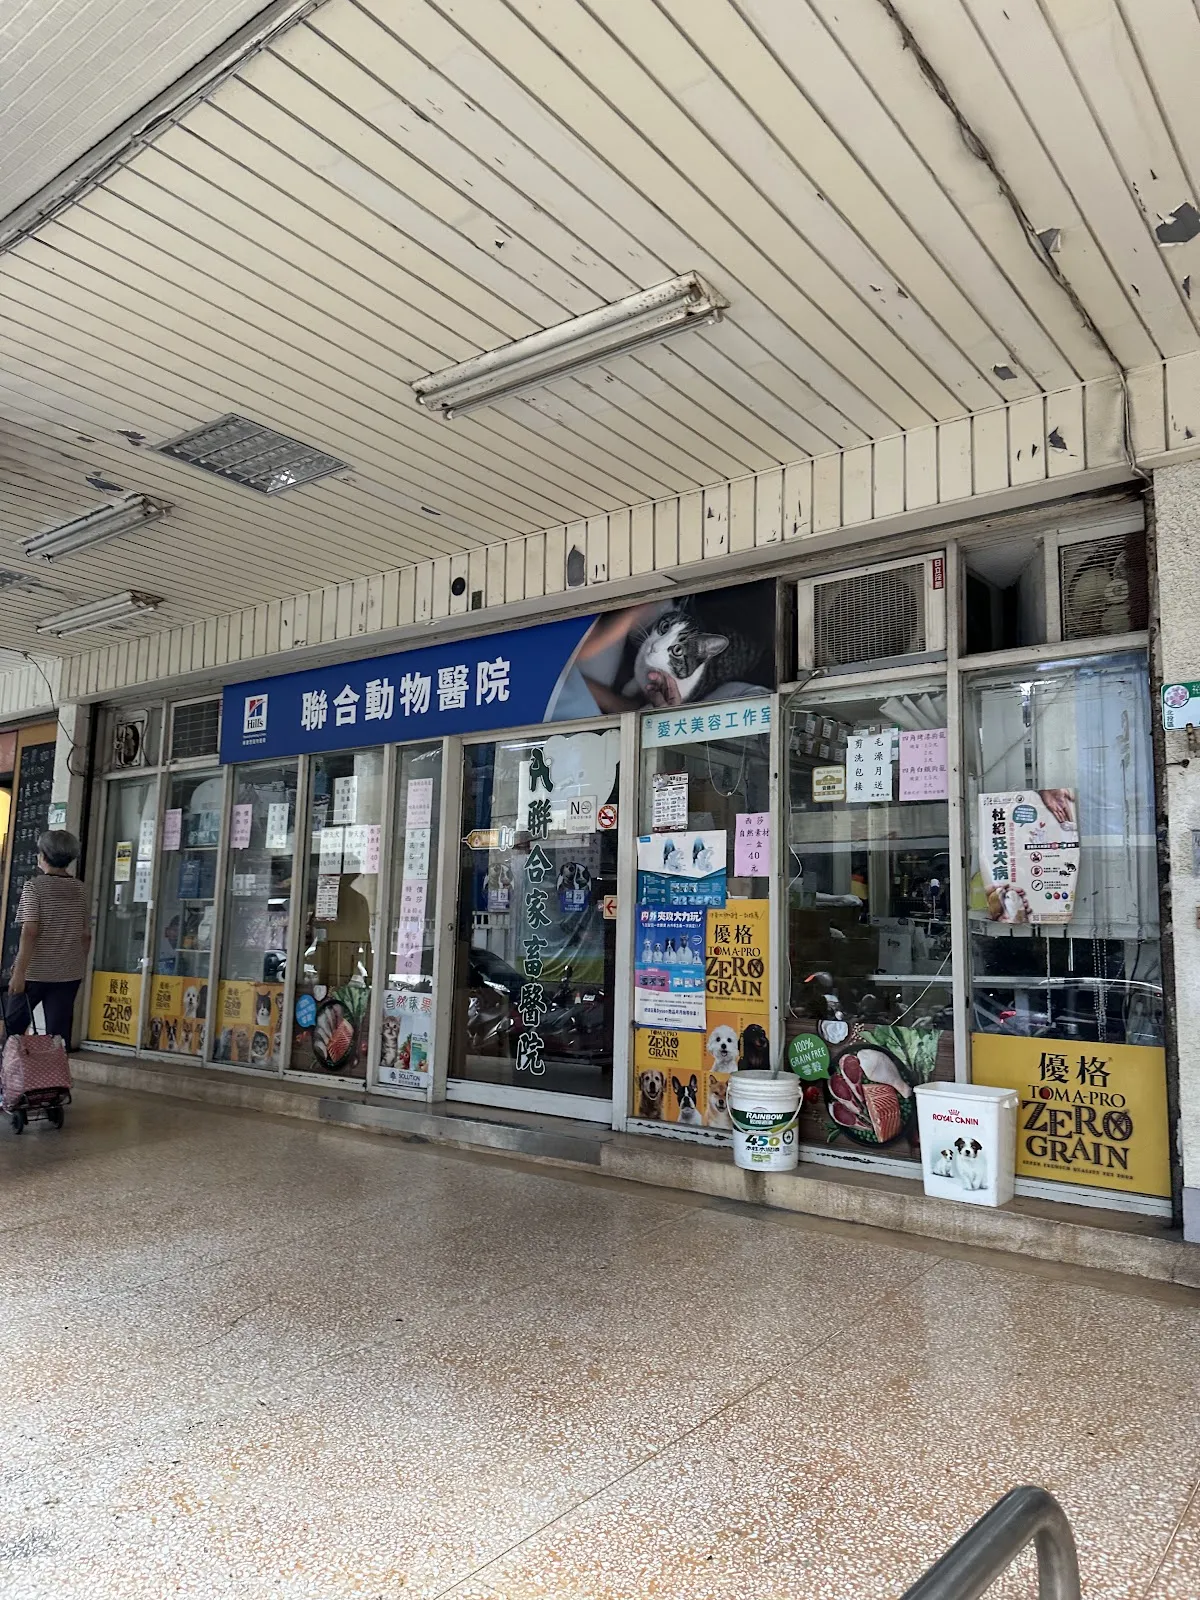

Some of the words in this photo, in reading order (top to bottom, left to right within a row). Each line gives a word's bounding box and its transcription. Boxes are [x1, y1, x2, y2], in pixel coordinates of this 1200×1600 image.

[301, 656, 511, 731] 聯合動物醫院
[247, 718, 264, 729] Hill's
[657, 706, 771, 738] 愛犬美容工作室
[739, 828, 769, 837] 自然素材
[748, 851, 760, 860] 40
[515, 797, 553, 1075] 聯合家畜醫院
[714, 924, 753, 945] 優格
[708, 945, 761, 957] TOMA-PRO
[705, 956, 764, 979] ZERO
[109, 978, 129, 996] 優格
[706, 977, 762, 996] GRAIN
[103, 1003, 132, 1022] ZERO
[385, 994, 432, 1013] 自然蔬果
[102, 1020, 130, 1035] GRAIN
[648, 1035, 679, 1048] ZERO
[794, 1037, 814, 1053] 100%
[648, 1048, 678, 1058] GRAIN
[790, 1052, 811, 1067] GRAIN
[811, 1047, 826, 1059] FREE
[398, 1073, 421, 1081] SOLUTION
[1038, 1052, 1111, 1088] 優格
[1028, 1085, 1126, 1108] TOMA-PRO
[745, 1112, 784, 1120] RAINBOW
[932, 1113, 954, 1123] ROYAL
[954, 1116, 979, 1126] CANIN
[1022, 1100, 1133, 1141] ZERO
[745, 1134, 781, 1147] 450
[1025, 1137, 1130, 1170] GRAIN
